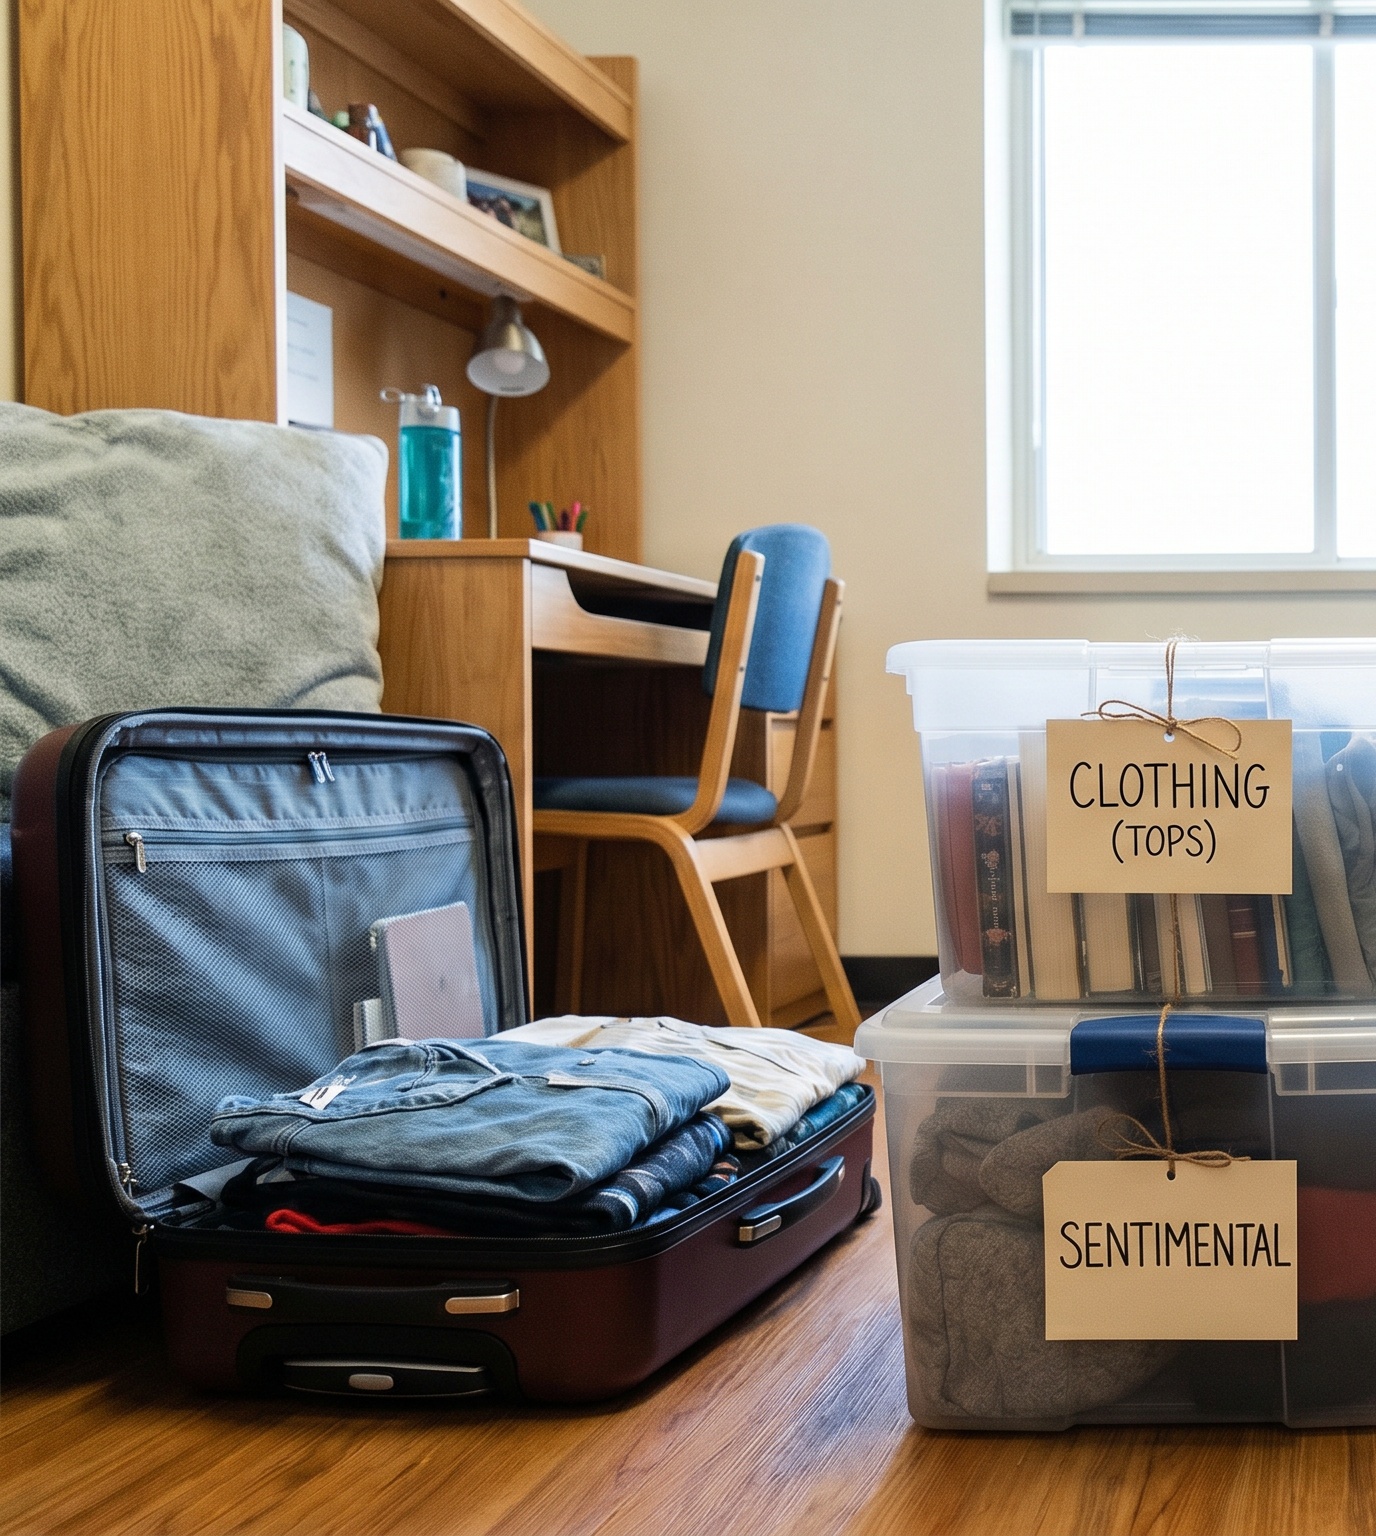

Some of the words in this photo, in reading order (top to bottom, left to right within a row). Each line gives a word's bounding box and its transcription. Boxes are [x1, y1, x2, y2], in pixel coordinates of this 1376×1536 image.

[1069, 761, 1270, 809] CLOTHING
[1111, 818, 1217, 864] (TOPS)
[1059, 1220, 1292, 1269] SENTIMENTAL
